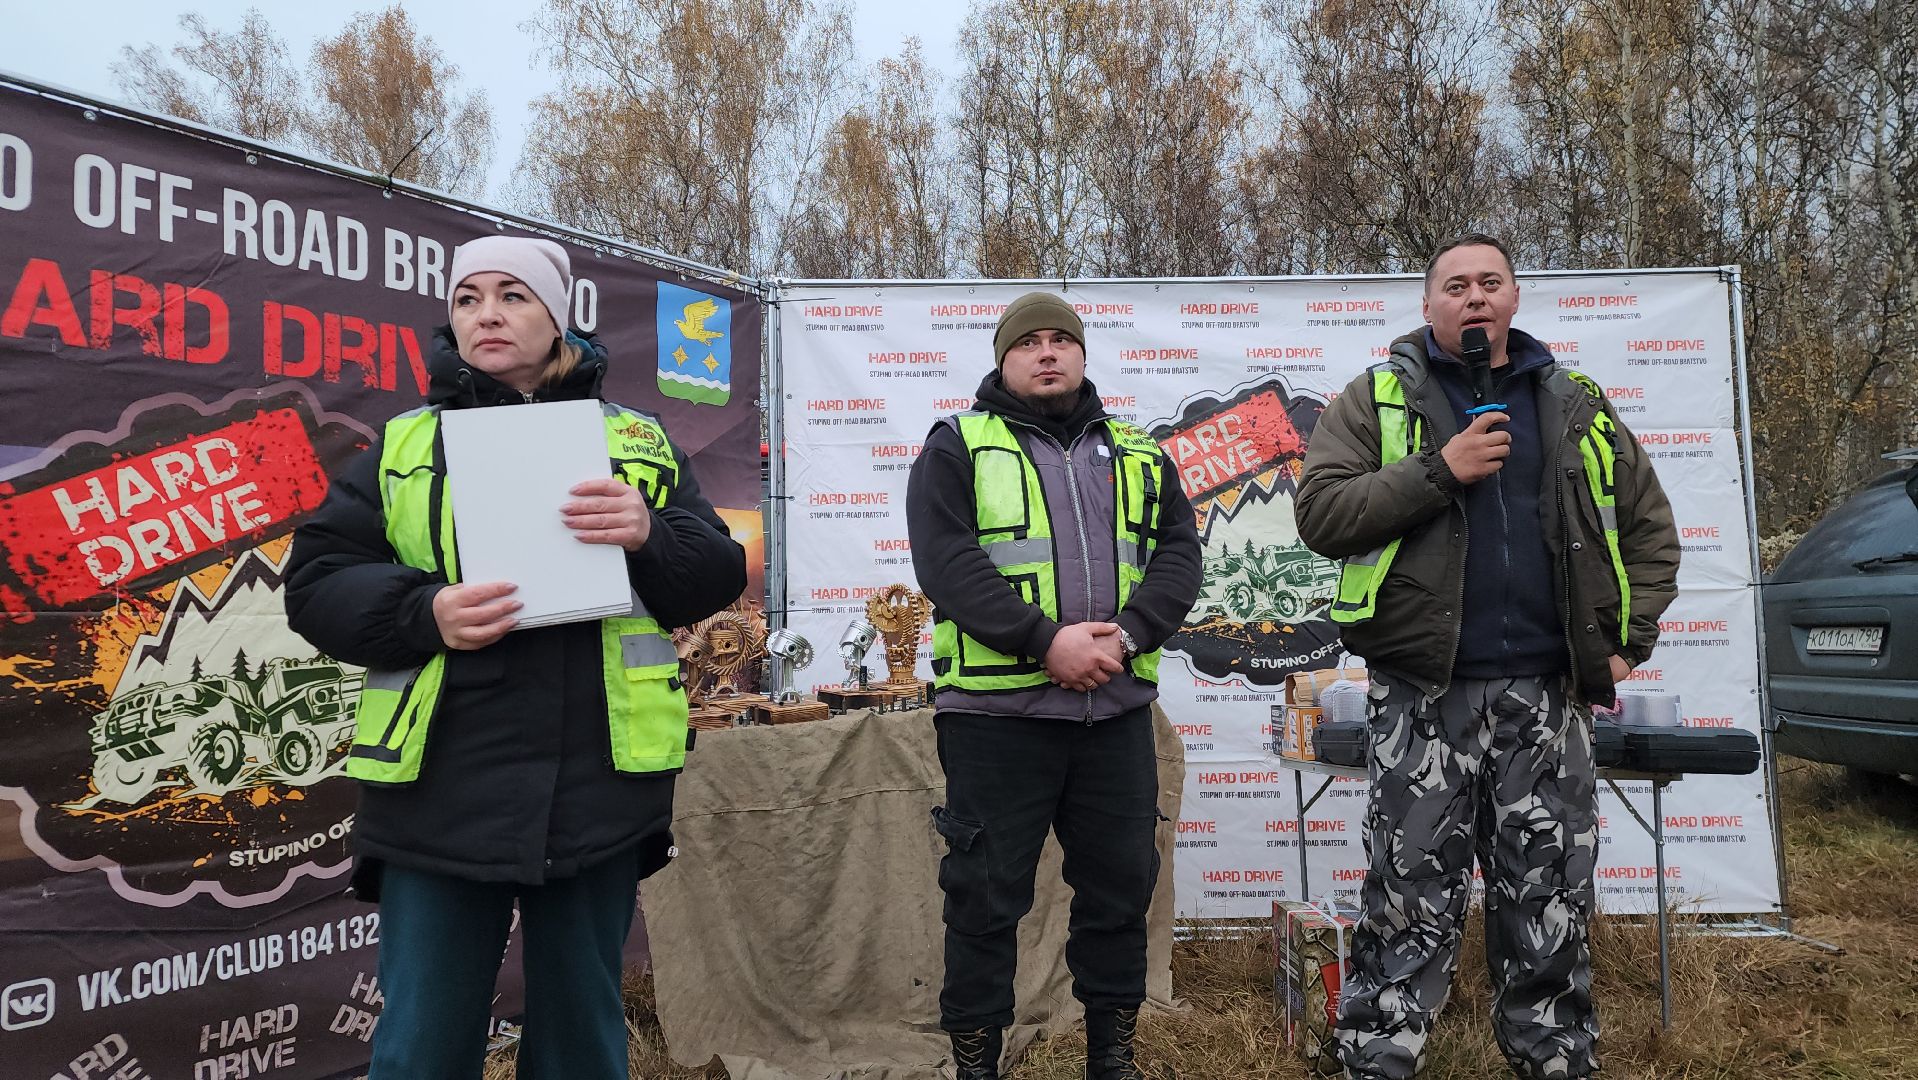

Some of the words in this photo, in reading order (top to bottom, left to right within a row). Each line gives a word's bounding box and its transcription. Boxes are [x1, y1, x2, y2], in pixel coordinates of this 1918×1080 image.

[74, 153, 368, 281] OFF-ROAD
[1306, 302, 1342, 313] HARD
[1346, 301, 1384, 312] DRIVE
[1558, 297, 1595, 308] HARD
[1599, 295, 1638, 307] DRIVE
[805, 306, 841, 317] HARD
[845, 305, 883, 317] DRIVE
[931, 305, 967, 316] HARD
[1096, 304, 1134, 315] DRIVE
[1181, 304, 1217, 315] HARD
[1221, 303, 1259, 314] DRIVE
[2, 257, 229, 364] ARD
[263, 301, 431, 397] DRIV
[1549, 341, 1579, 353] RIVE
[1627, 340, 1663, 352] HARD
[1666, 339, 1706, 351] DRIVE
[868, 352, 905, 364] HARD
[909, 351, 948, 363] DRIVE
[1120, 349, 1156, 361] HARD
[1160, 348, 1198, 360] DRIVE
[1246, 348, 1283, 359] HARD
[1285, 347, 1324, 358] DRIVE
[1606, 387, 1644, 399] DRIVE
[807, 399, 844, 411] HARD
[847, 398, 886, 411] DRIVE
[933, 398, 970, 410] HARD
[1672, 432, 1712, 444] DRIVE
[871, 445, 908, 457] HARD
[51, 437, 239, 535] HARD
[809, 493, 847, 505] HARD
[850, 492, 889, 505] DRIVE
[77, 482, 272, 586] DRIVE
[1681, 527, 1719, 538] DRIVE
[874, 539, 911, 551] HARD
[811, 588, 849, 600] HARD
[1657, 621, 1684, 633] ARD
[1688, 620, 1728, 632] DRIVE
[1250, 654, 1310, 669] STUPINO
[1199, 773, 1236, 785] HARD
[1240, 772, 1279, 784] DRIVE
[1177, 821, 1217, 834] DRIVE
[1307, 820, 1346, 832] DRIVE
[1701, 815, 1744, 828] DRIVE
[1664, 836, 1685, 844] TUPINO
[229, 832, 327, 867] STUPINO
[1202, 871, 1241, 883] HARD
[1244, 870, 1284, 883] DRIVE
[1597, 867, 1637, 879] HARD
[199, 1003, 298, 1053] HARD
[329, 1004, 380, 1043] DRI
[193, 1037, 297, 1080] DRIVE
